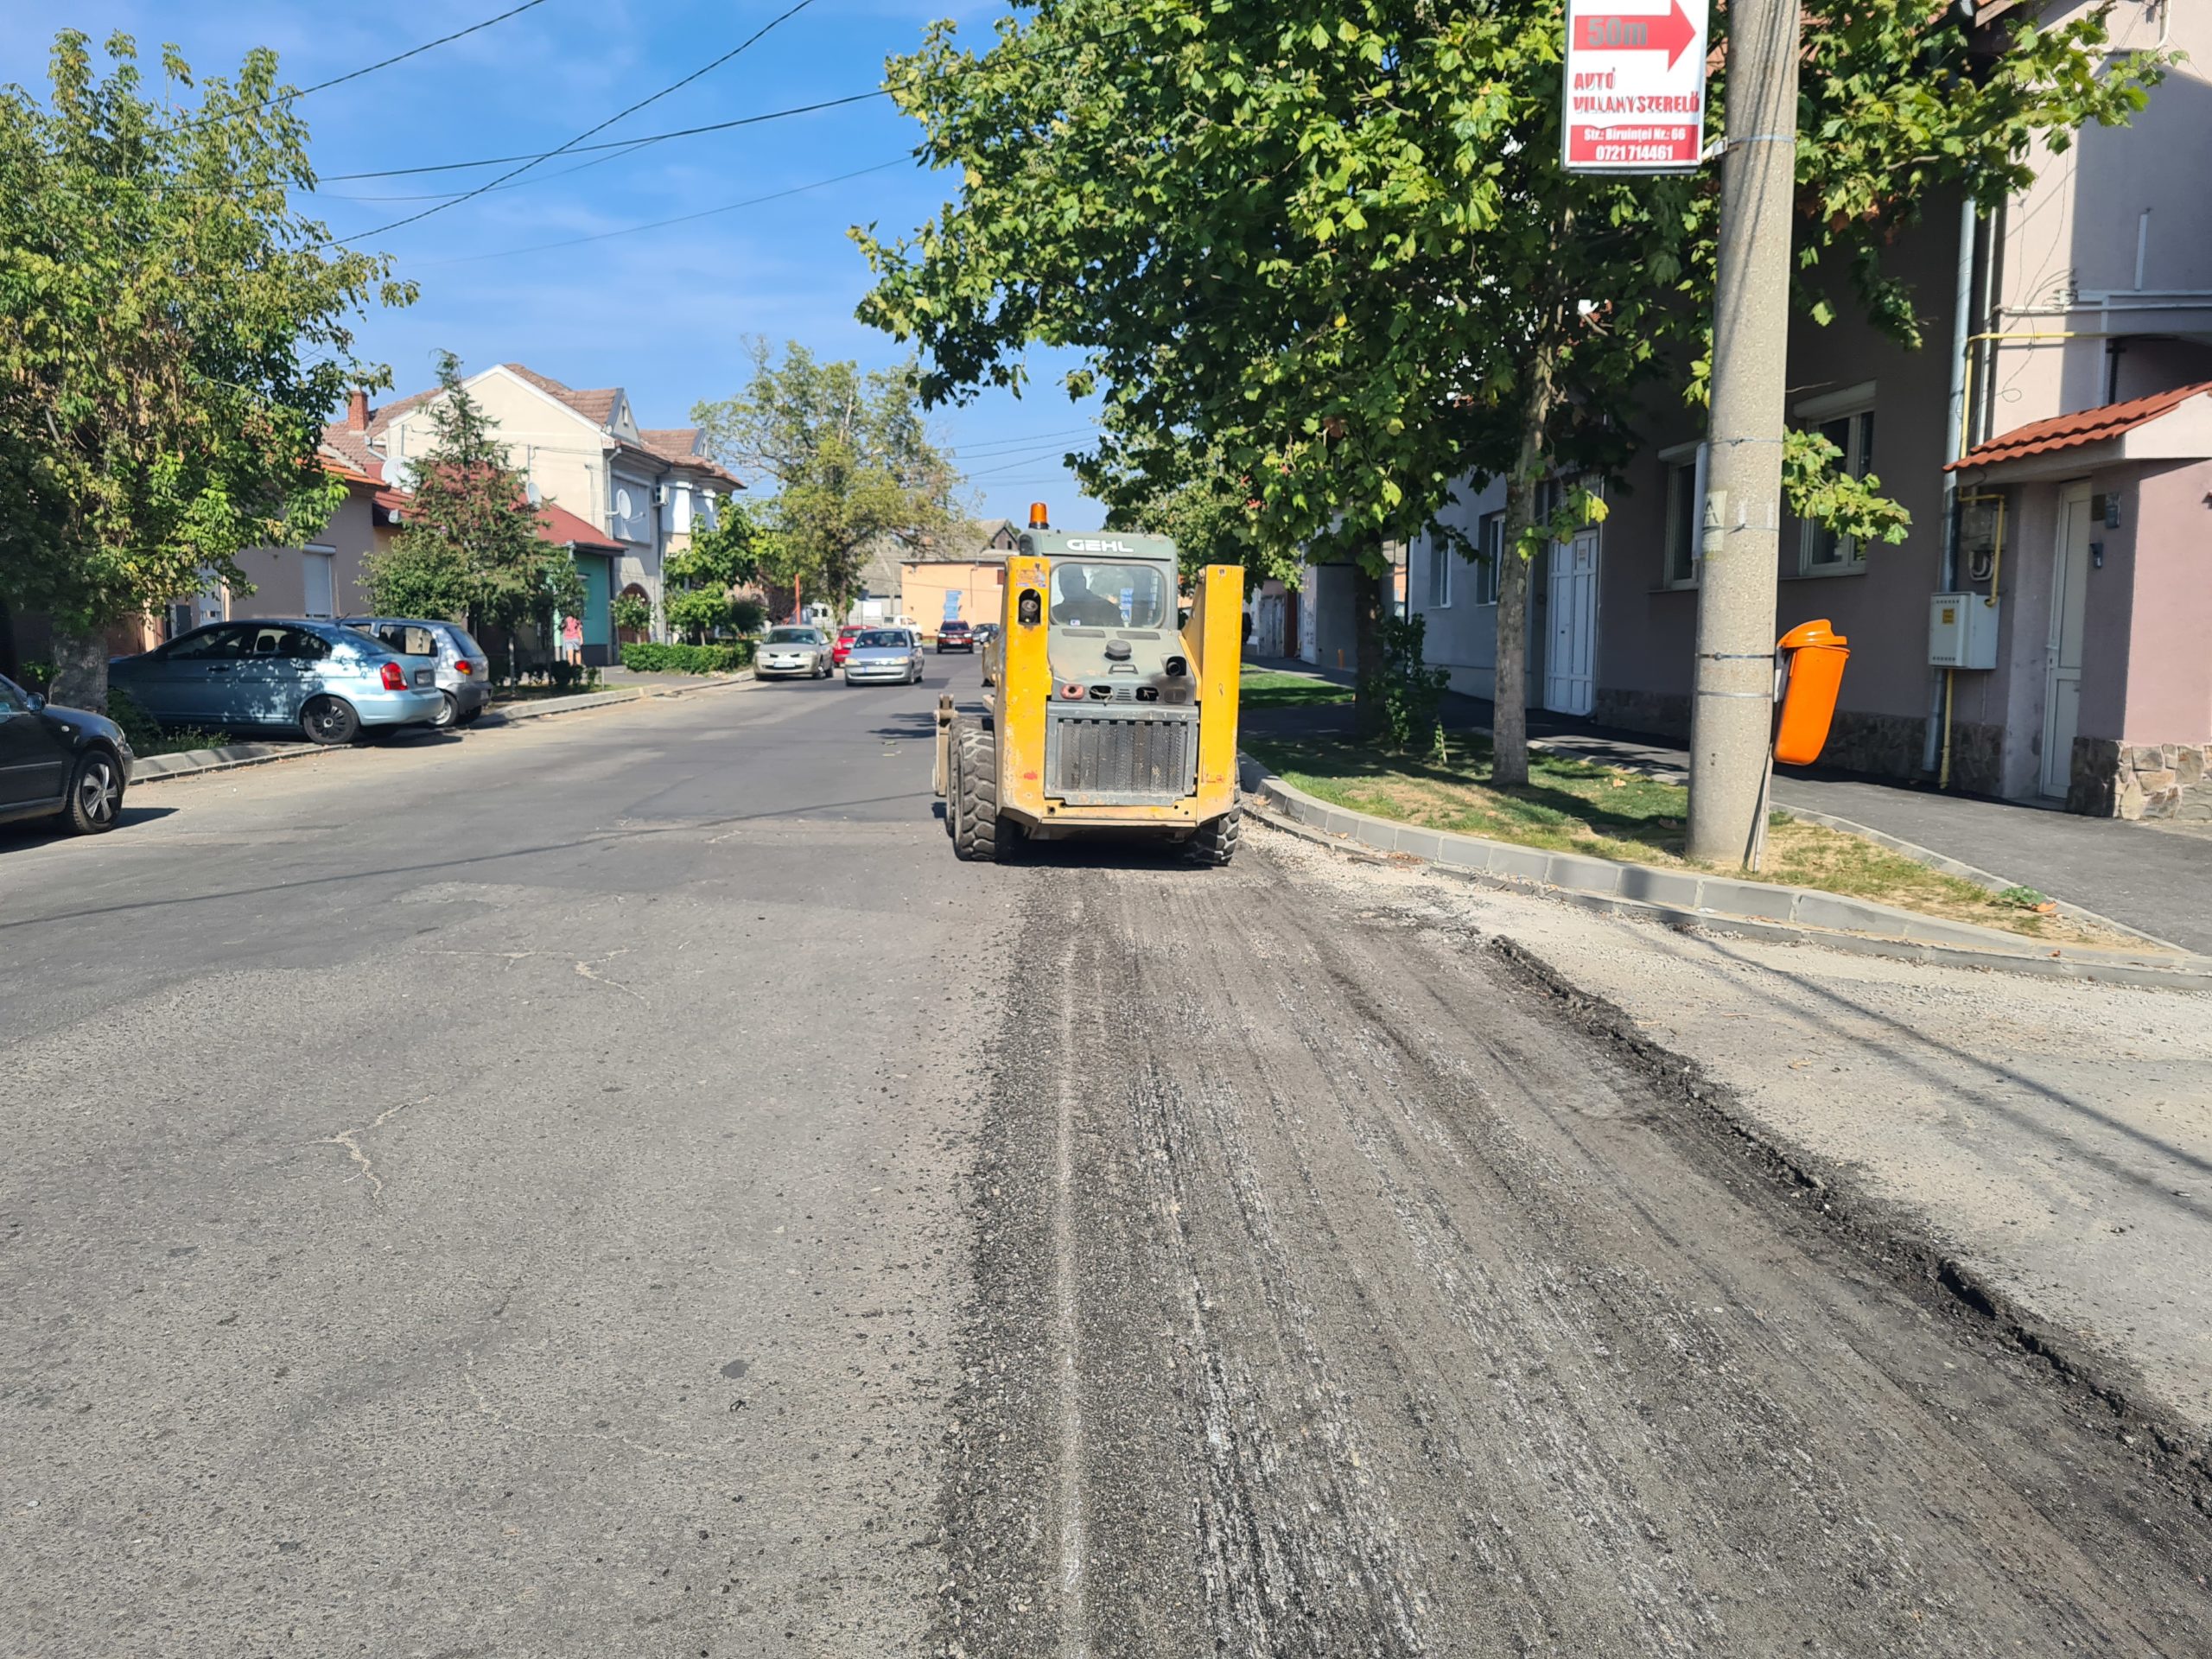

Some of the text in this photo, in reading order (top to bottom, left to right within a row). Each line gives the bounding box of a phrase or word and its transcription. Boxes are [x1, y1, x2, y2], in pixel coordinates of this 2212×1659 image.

[1587, 17, 1647, 47] 50m
[1671, 127, 1687, 141] 66
[1066, 538, 1135, 553] GEHL
